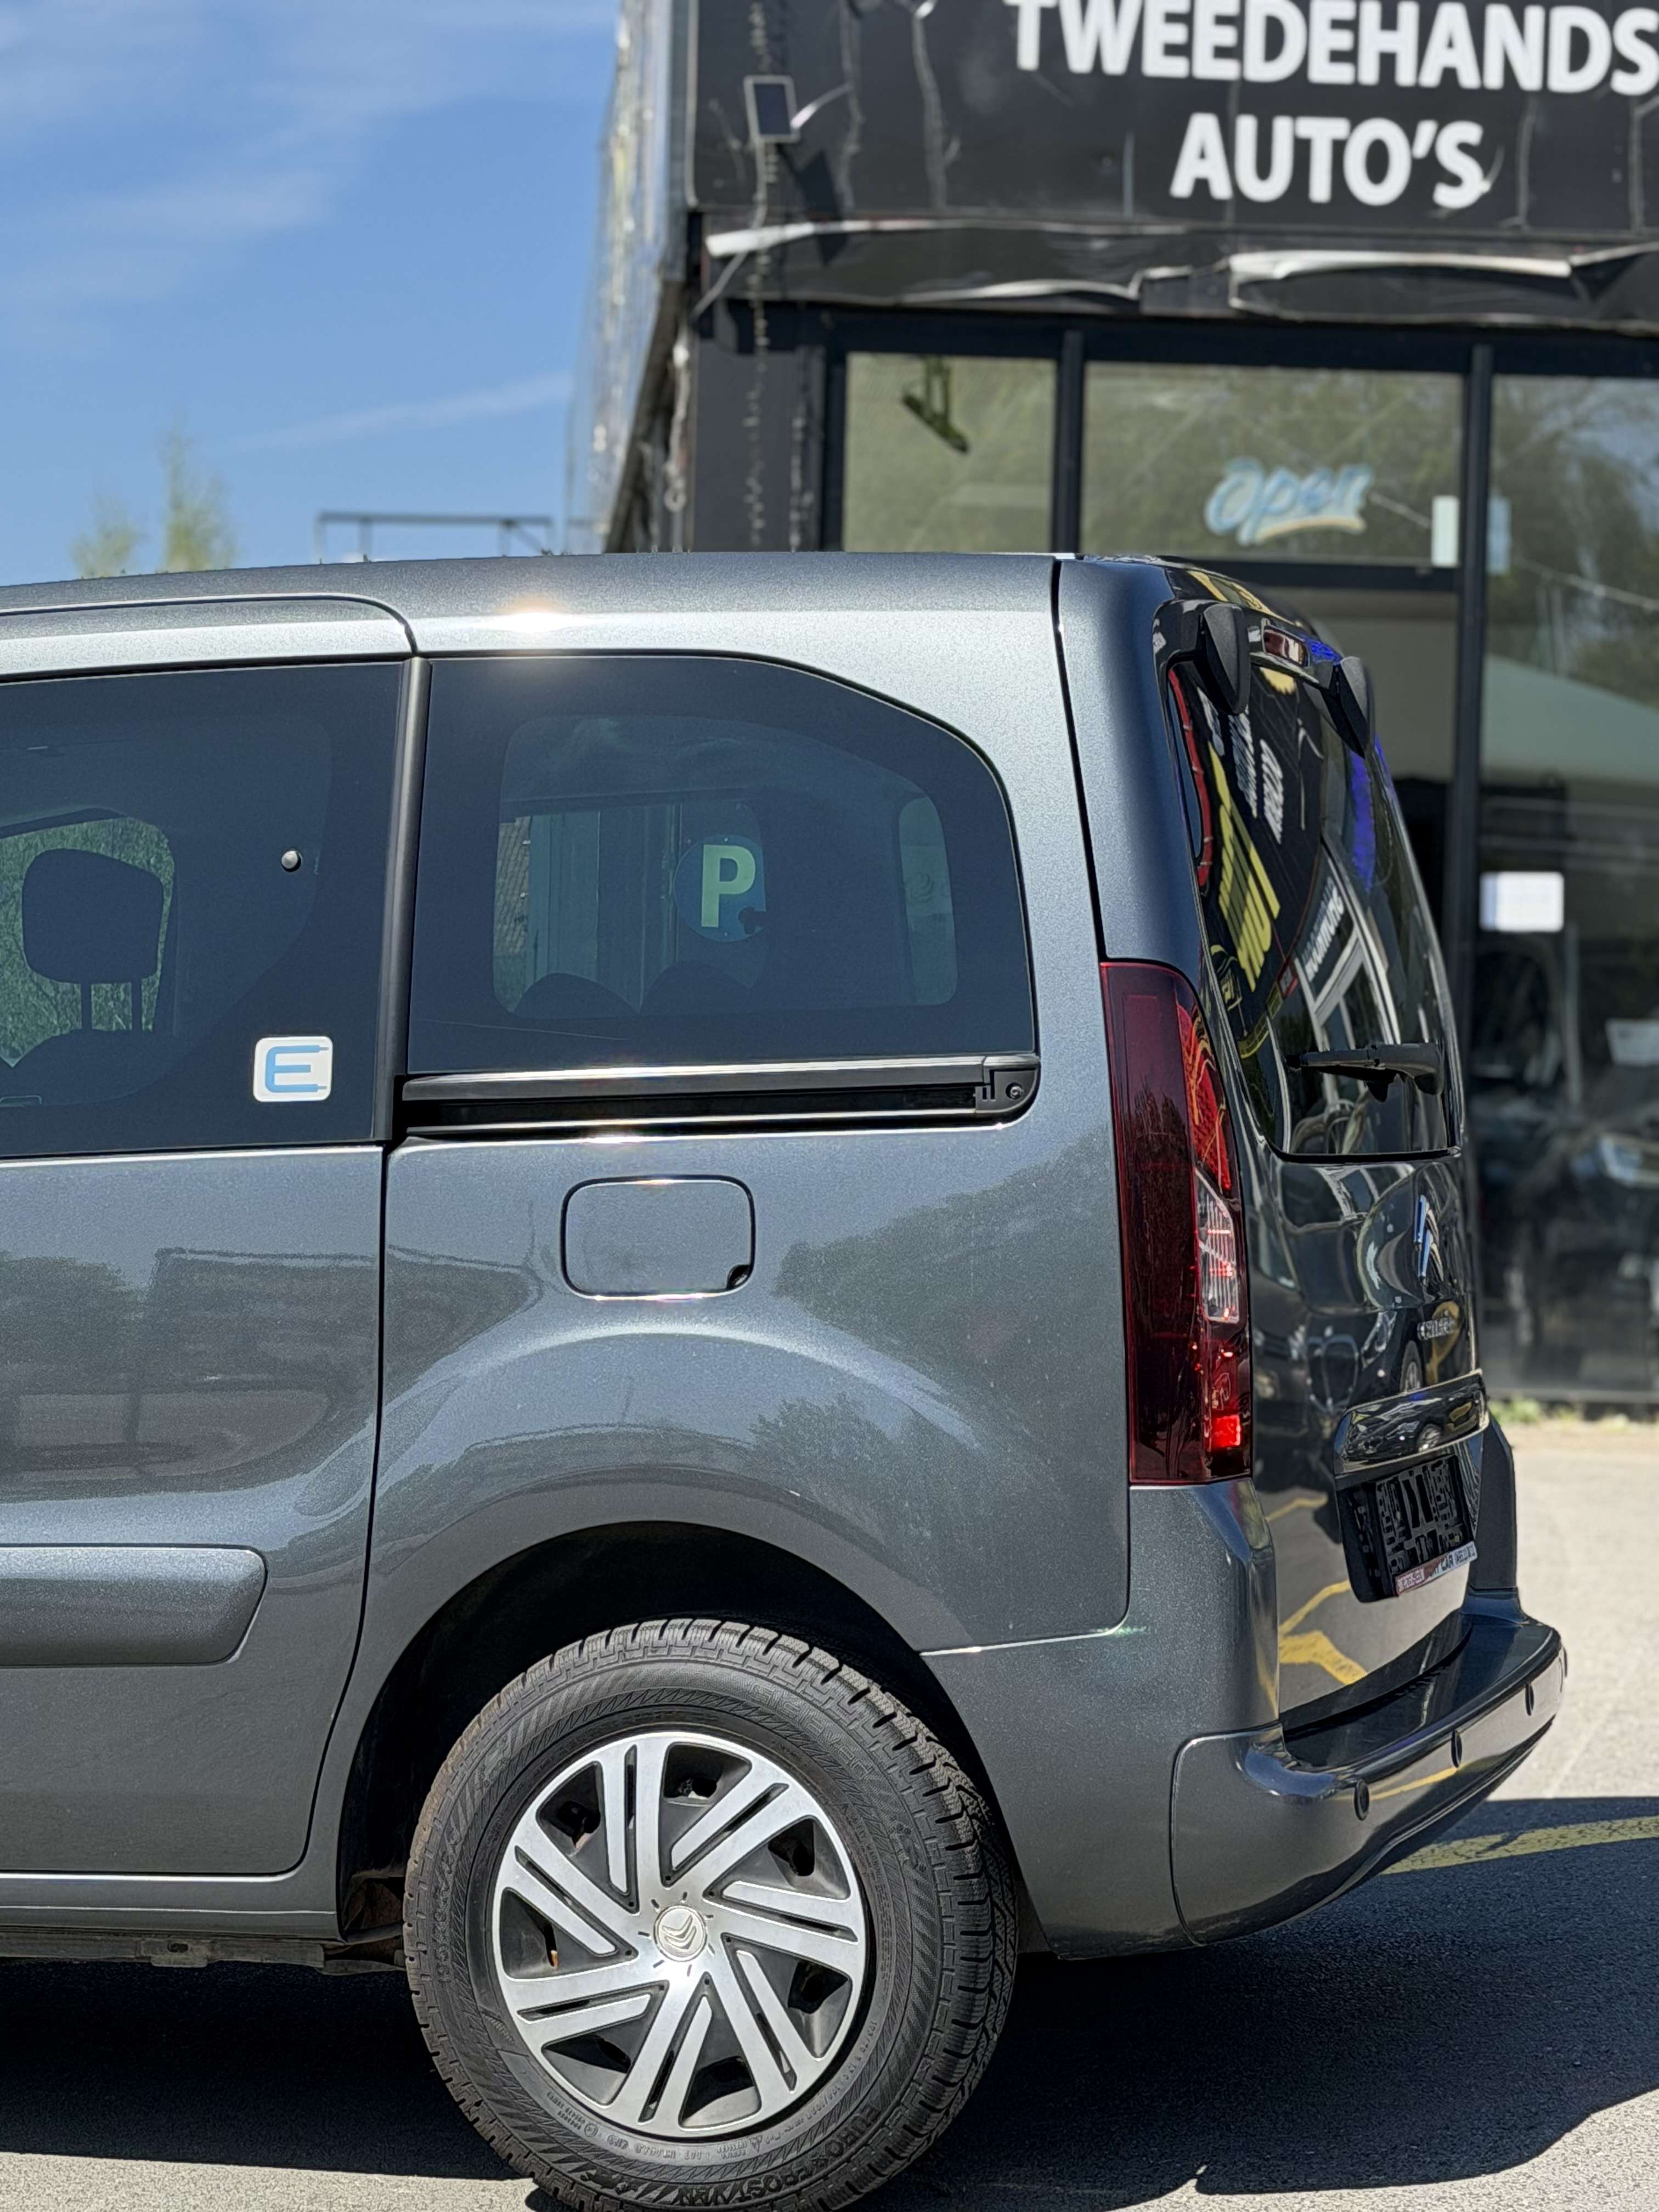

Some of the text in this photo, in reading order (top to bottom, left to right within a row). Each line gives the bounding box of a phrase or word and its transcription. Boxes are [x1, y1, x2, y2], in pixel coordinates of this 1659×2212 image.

[1004, 0, 1659, 96] TWEEDEHANDS
[1170, 112, 1485, 208] AUTO'S
[701, 844, 756, 928] P
